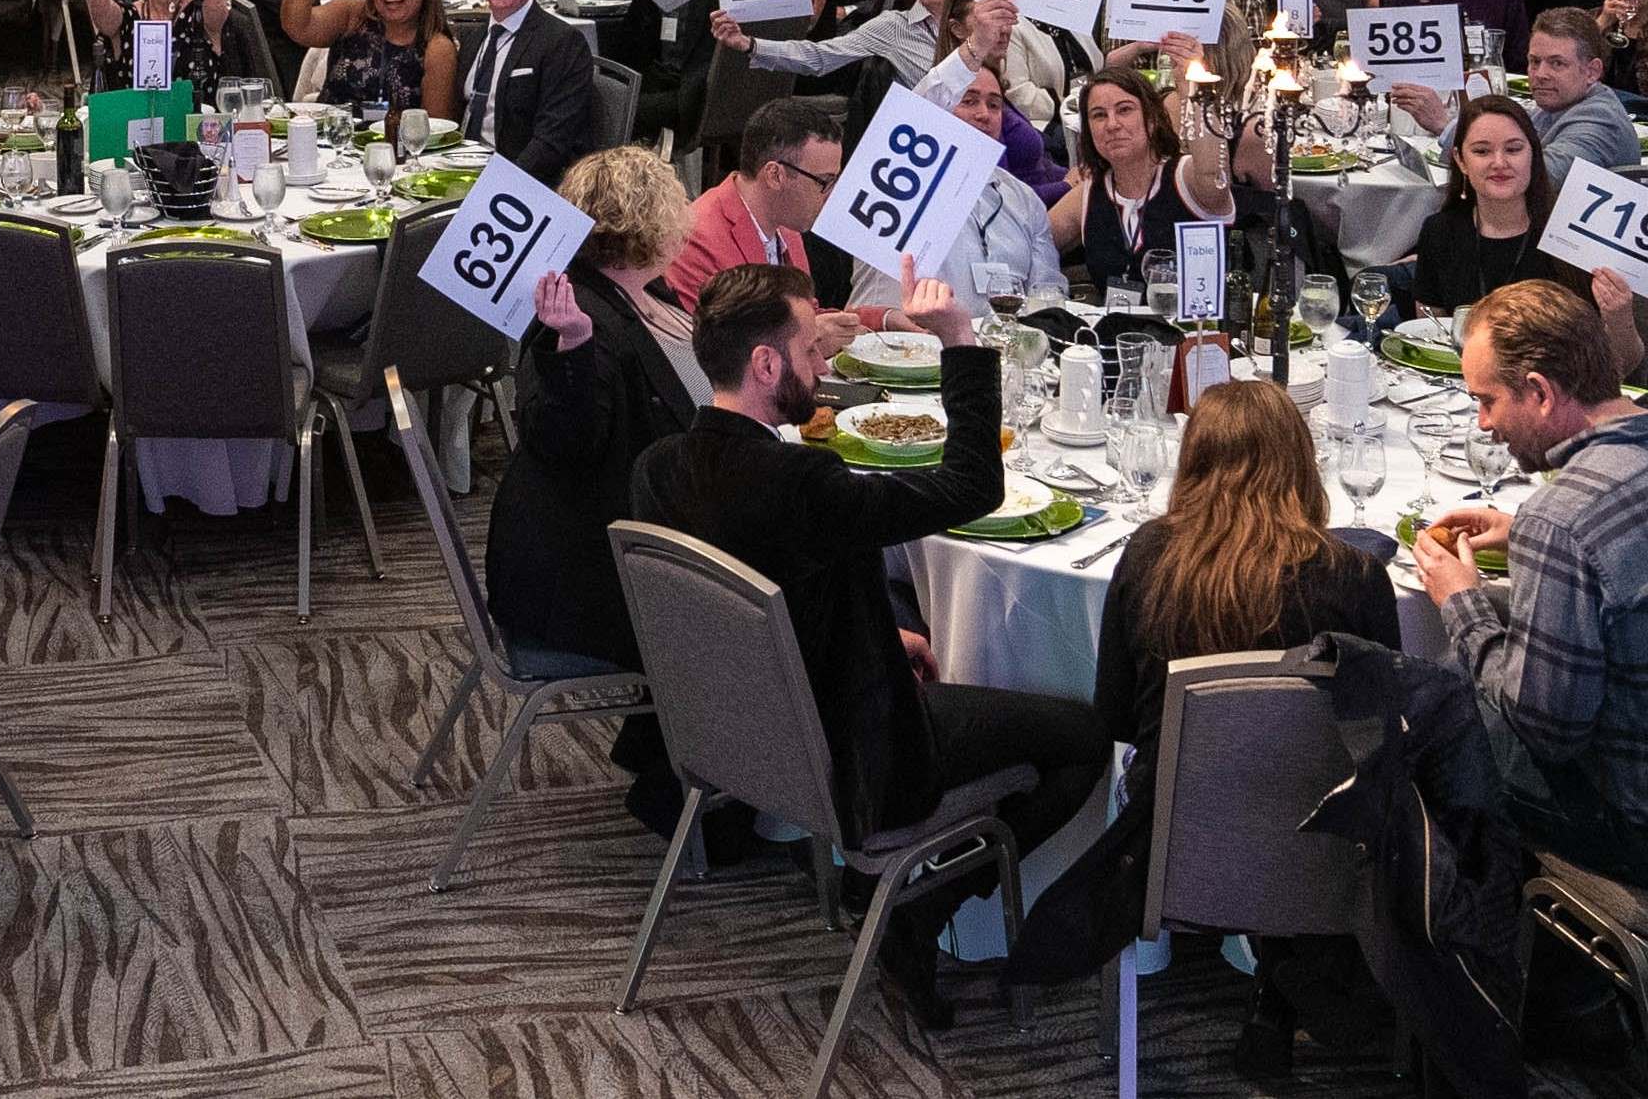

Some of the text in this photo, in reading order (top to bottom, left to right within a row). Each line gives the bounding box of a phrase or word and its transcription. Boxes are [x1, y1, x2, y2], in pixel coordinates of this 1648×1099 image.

[1291, 10, 1298, 20] 8
[142, 37, 163, 45] Table
[1368, 20, 1442, 56] 585
[149, 60, 156, 70] 7
[849, 124, 939, 237] 568
[454, 193, 533, 289] 630
[1188, 247, 1214, 256] Table
[1197, 278, 1205, 291] 3
